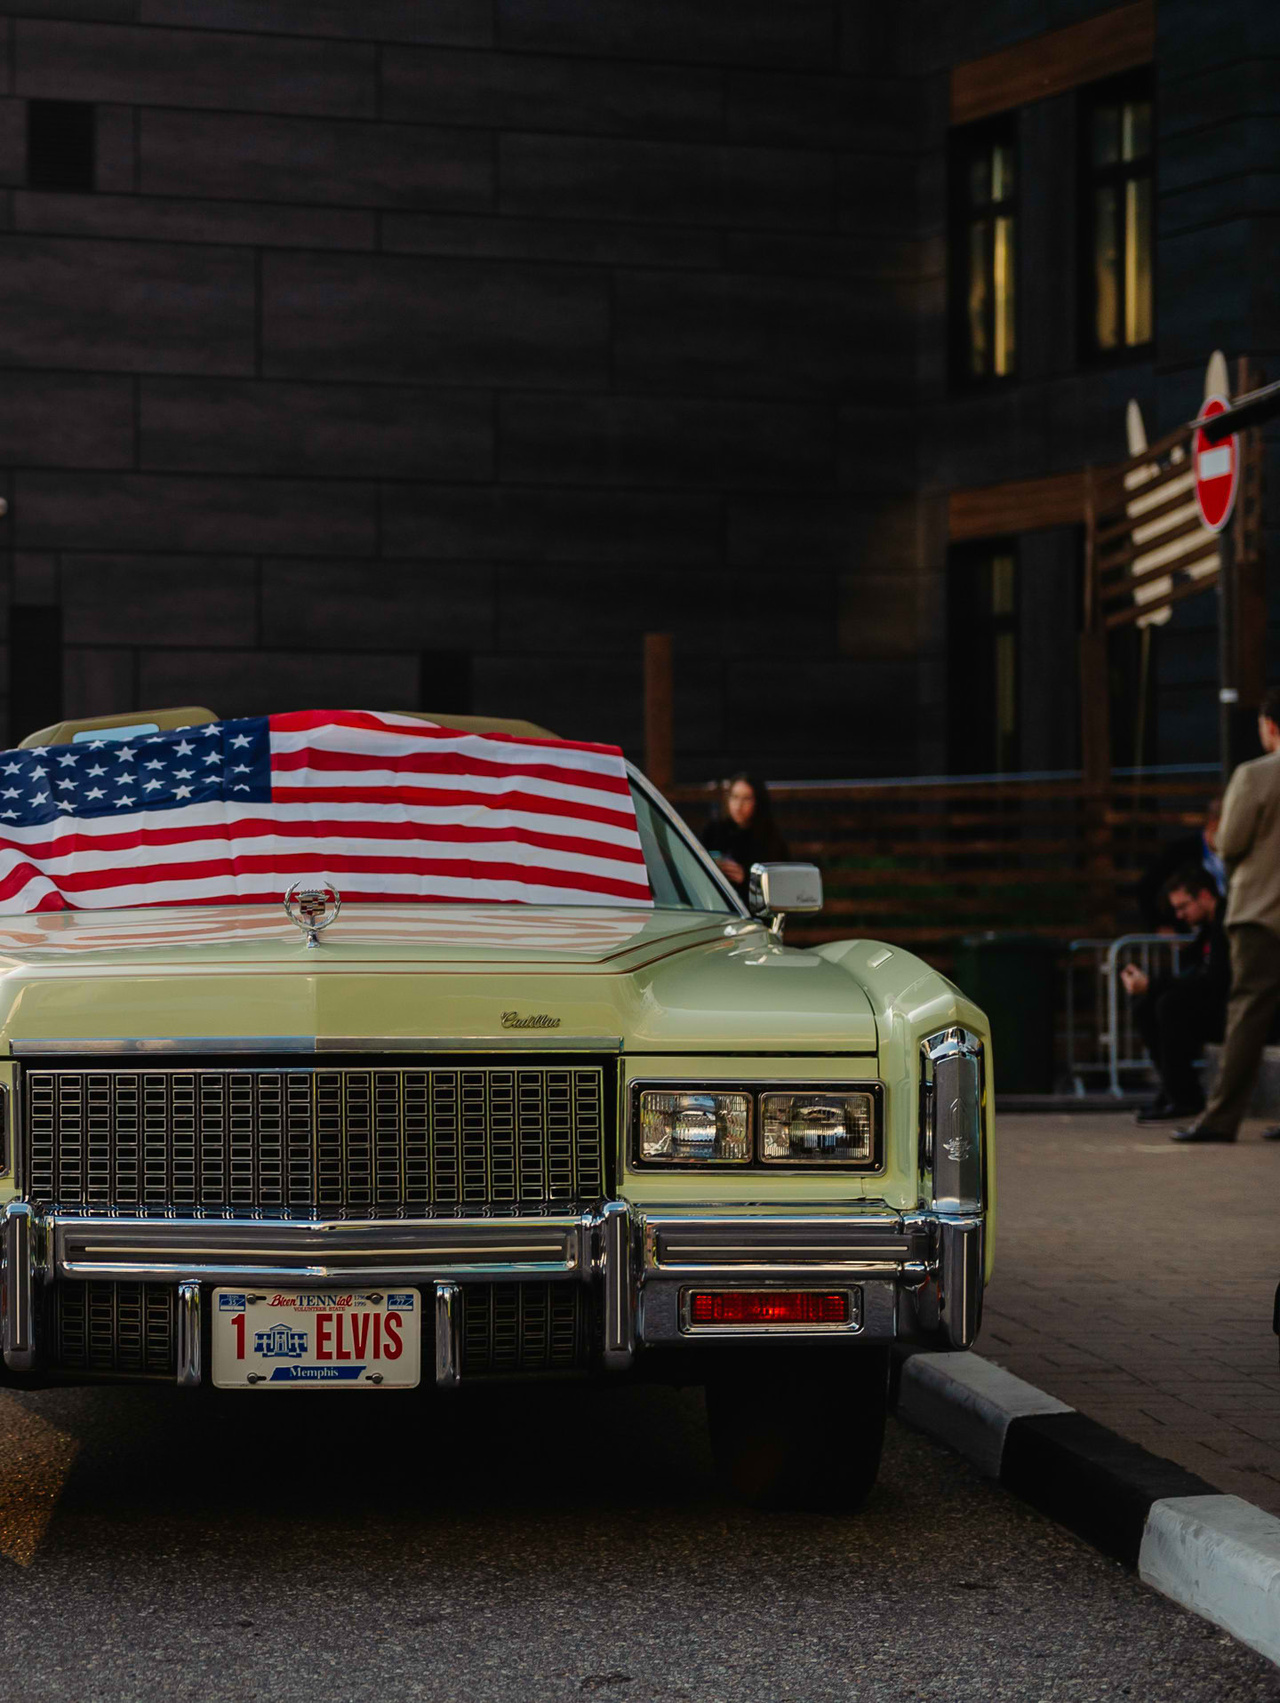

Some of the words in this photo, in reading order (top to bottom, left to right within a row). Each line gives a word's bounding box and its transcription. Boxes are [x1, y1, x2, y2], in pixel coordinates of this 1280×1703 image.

[501, 1011, 561, 1028] Cadillac
[267, 1294, 353, 1307] BicenTENNial
[231, 1313, 246, 1360] 1
[316, 1312, 403, 1361] ELVIS
[290, 1367, 339, 1380] Memphis
